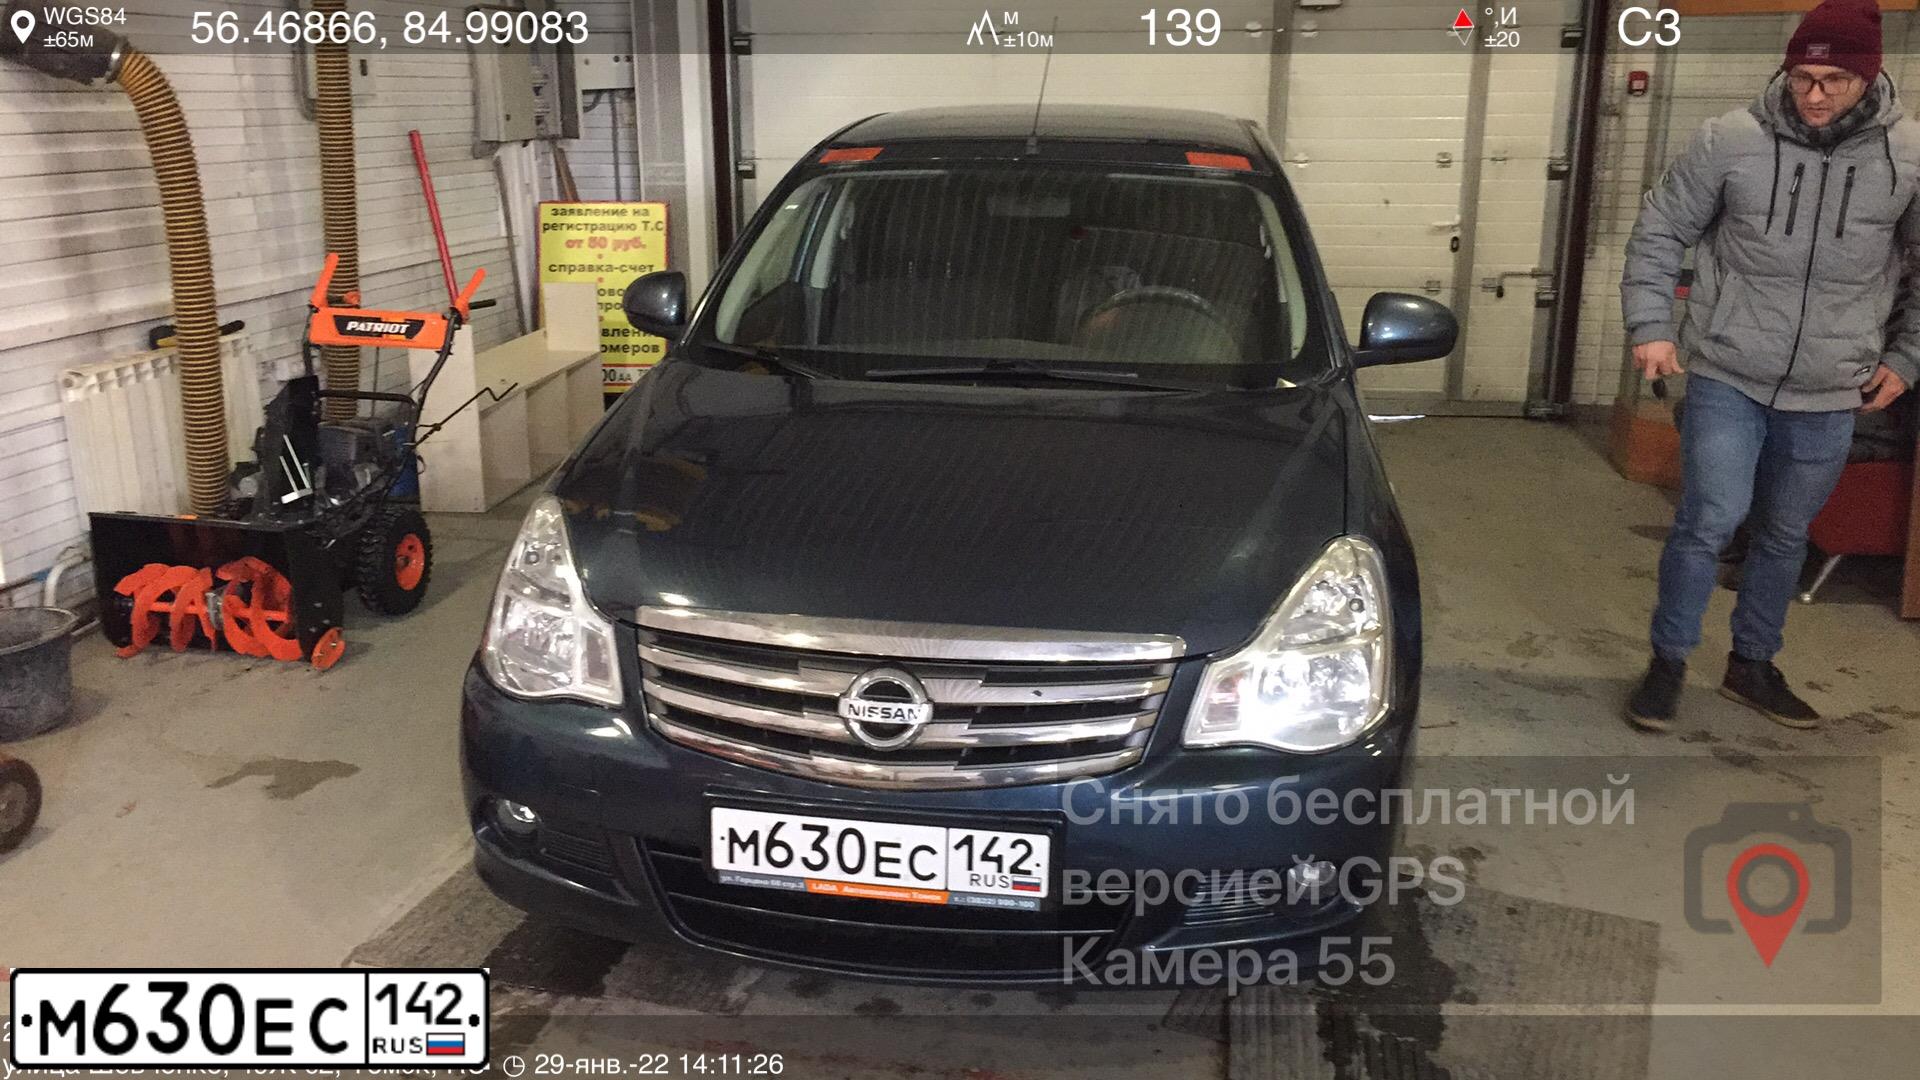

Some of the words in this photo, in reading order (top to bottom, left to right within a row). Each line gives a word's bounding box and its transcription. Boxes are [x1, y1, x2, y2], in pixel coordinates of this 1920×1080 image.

[551, 207, 628, 217] заявление
[632, 207, 650, 217] на
[542, 222, 637, 233] регистрацию
[565, 239, 583, 249] от
[612, 236, 647, 252] руб.
[548, 263, 654, 275] справка-счет
[346, 321, 410, 334] PATRIOT
[600, 343, 660, 356] омеров
[847, 703, 921, 720] NISSAN
[954, 834, 1033, 875] 142
[969, 872, 1010, 888] RUS
